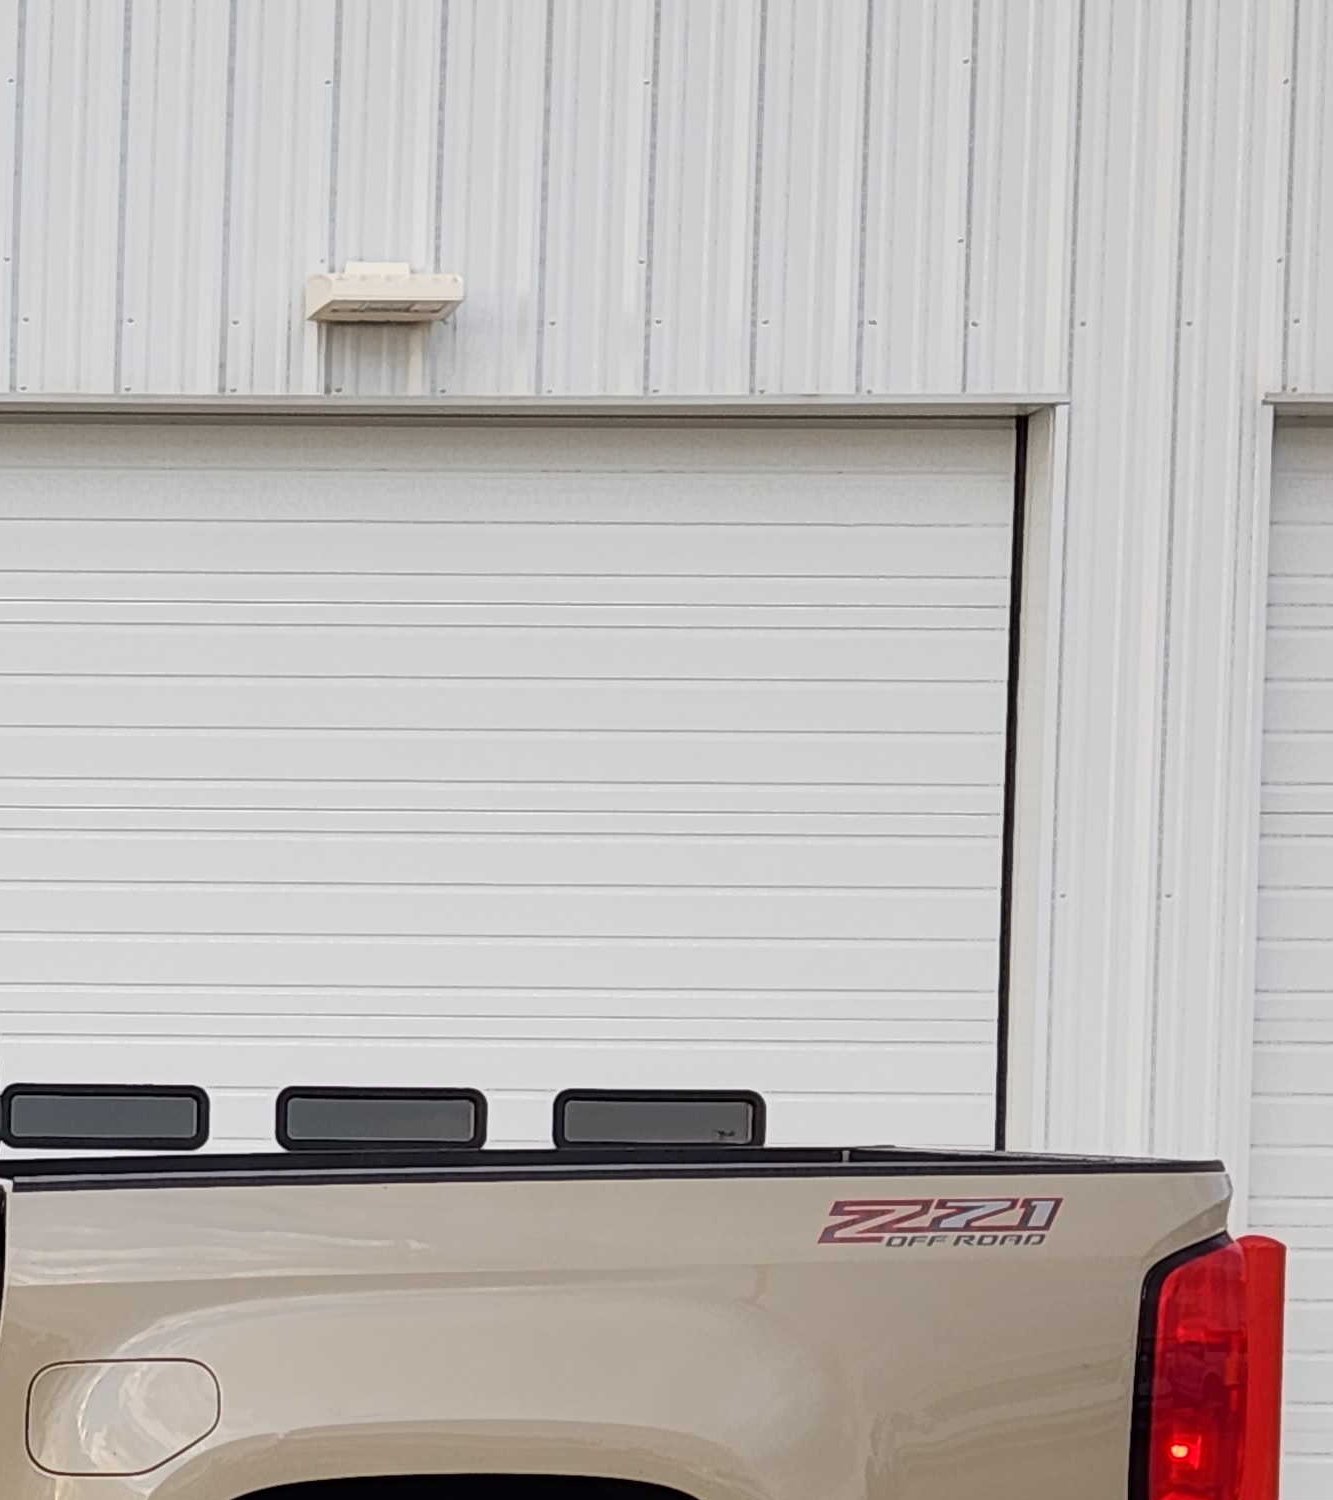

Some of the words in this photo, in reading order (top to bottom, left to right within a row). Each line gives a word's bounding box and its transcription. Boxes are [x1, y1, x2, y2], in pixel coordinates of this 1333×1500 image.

[817, 1197, 1065, 1244] Z71
[885, 1234, 948, 1248] OFF
[953, 1233, 1047, 1247] ROAD
